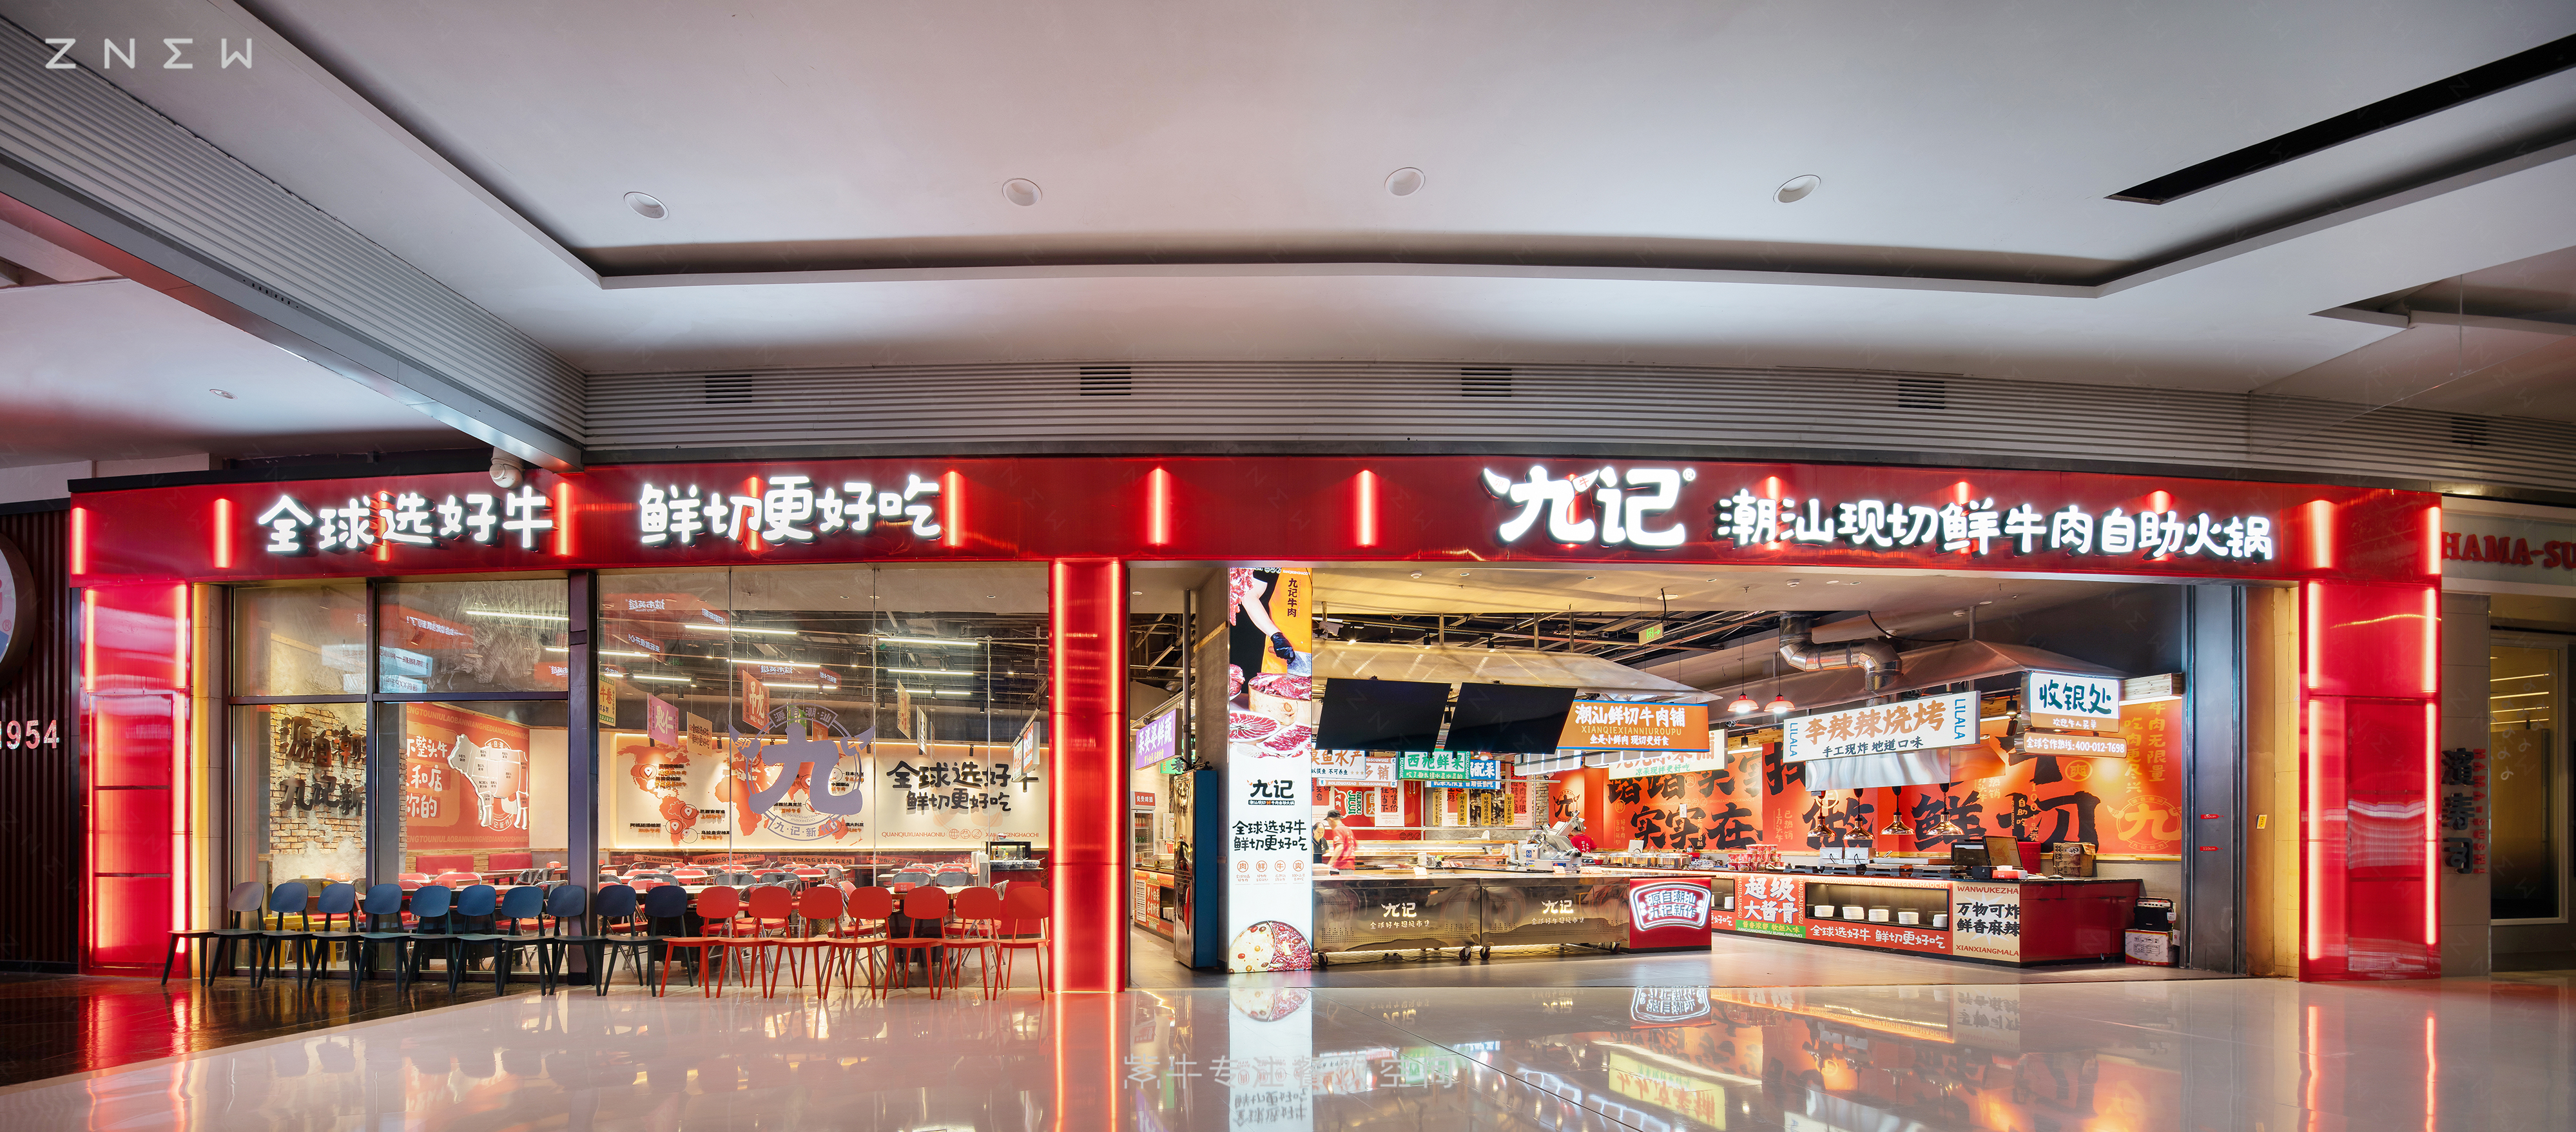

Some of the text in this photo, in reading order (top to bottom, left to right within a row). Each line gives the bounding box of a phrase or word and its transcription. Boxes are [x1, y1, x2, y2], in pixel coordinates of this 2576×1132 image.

[1579, 476, 1590, 488] 牛
[258, 474, 942, 552] 全球选好牛 鲜切更好吃
[1498, 465, 2272, 560] 九记 潮汕现切鲜牛肉自助火锅
[1287, 578, 1298, 618] 九记牛肉
[749, 681, 765, 719] 吊龙
[2039, 679, 2112, 714] 收银处
[1574, 703, 1686, 728] 潮汕鲜切牛肉铺
[1804, 699, 1946, 745] 李辣辣烧烤
[1954, 698, 1966, 740] LILALA
[2053, 718, 2097, 729] 欢迎牛人买单
[0, 719, 60, 750] 954
[1581, 725, 1682, 736] XIANQIEXIANNIUROUPU
[1589, 734, 1669, 746] 全是小鲜肉 现切更好食
[1790, 722, 1798, 757] LILALA
[2147, 702, 2166, 782] 牛肉无限量
[1823, 736, 1924, 758] 手工现炸 地道口味
[2124, 717, 2143, 794] 吃肉更尽兴
[748, 723, 862, 815] 九
[1407, 753, 1464, 770] 西施鲜果
[2069, 764, 2087, 777] 爽
[1249, 779, 1295, 799] 九记
[1687, 776, 1694, 786] 肉
[280, 775, 365, 817] 九记新
[906, 788, 1012, 812] 鲜切更好吃
[2016, 797, 2028, 827] 自助吃
[2118, 803, 2182, 841] 九
[1232, 819, 1307, 835] 全球选好牛
[1775, 807, 1783, 843] 1万头牛
[1784, 810, 1793, 840] 已热销
[1234, 835, 1308, 851] 鲜切更好吃
[1147, 886, 1160, 903] 萝卜白菜
[1743, 875, 1796, 903] 超级
[1808, 877, 1948, 889] QUANQIUXUANHAONIU XIANQIEGENGHAOCHI
[1957, 886, 2019, 895] WANWUKEZHA
[1541, 899, 1574, 914] 九记
[1644, 890, 1697, 906] 源自潮汕
[1381, 902, 1418, 918] 九记
[1647, 903, 1698, 921] 九记新作
[1743, 900, 1799, 924] 大酱骨
[1956, 901, 2020, 919] 万物可炸
[1772, 924, 1800, 933] 软烂入味
[1810, 924, 1946, 949] 全球选好牛 鲜切更好吃
[1956, 918, 2020, 937] 鲜香麻辣
[1956, 944, 2019, 957] XIANXIANGMALA
